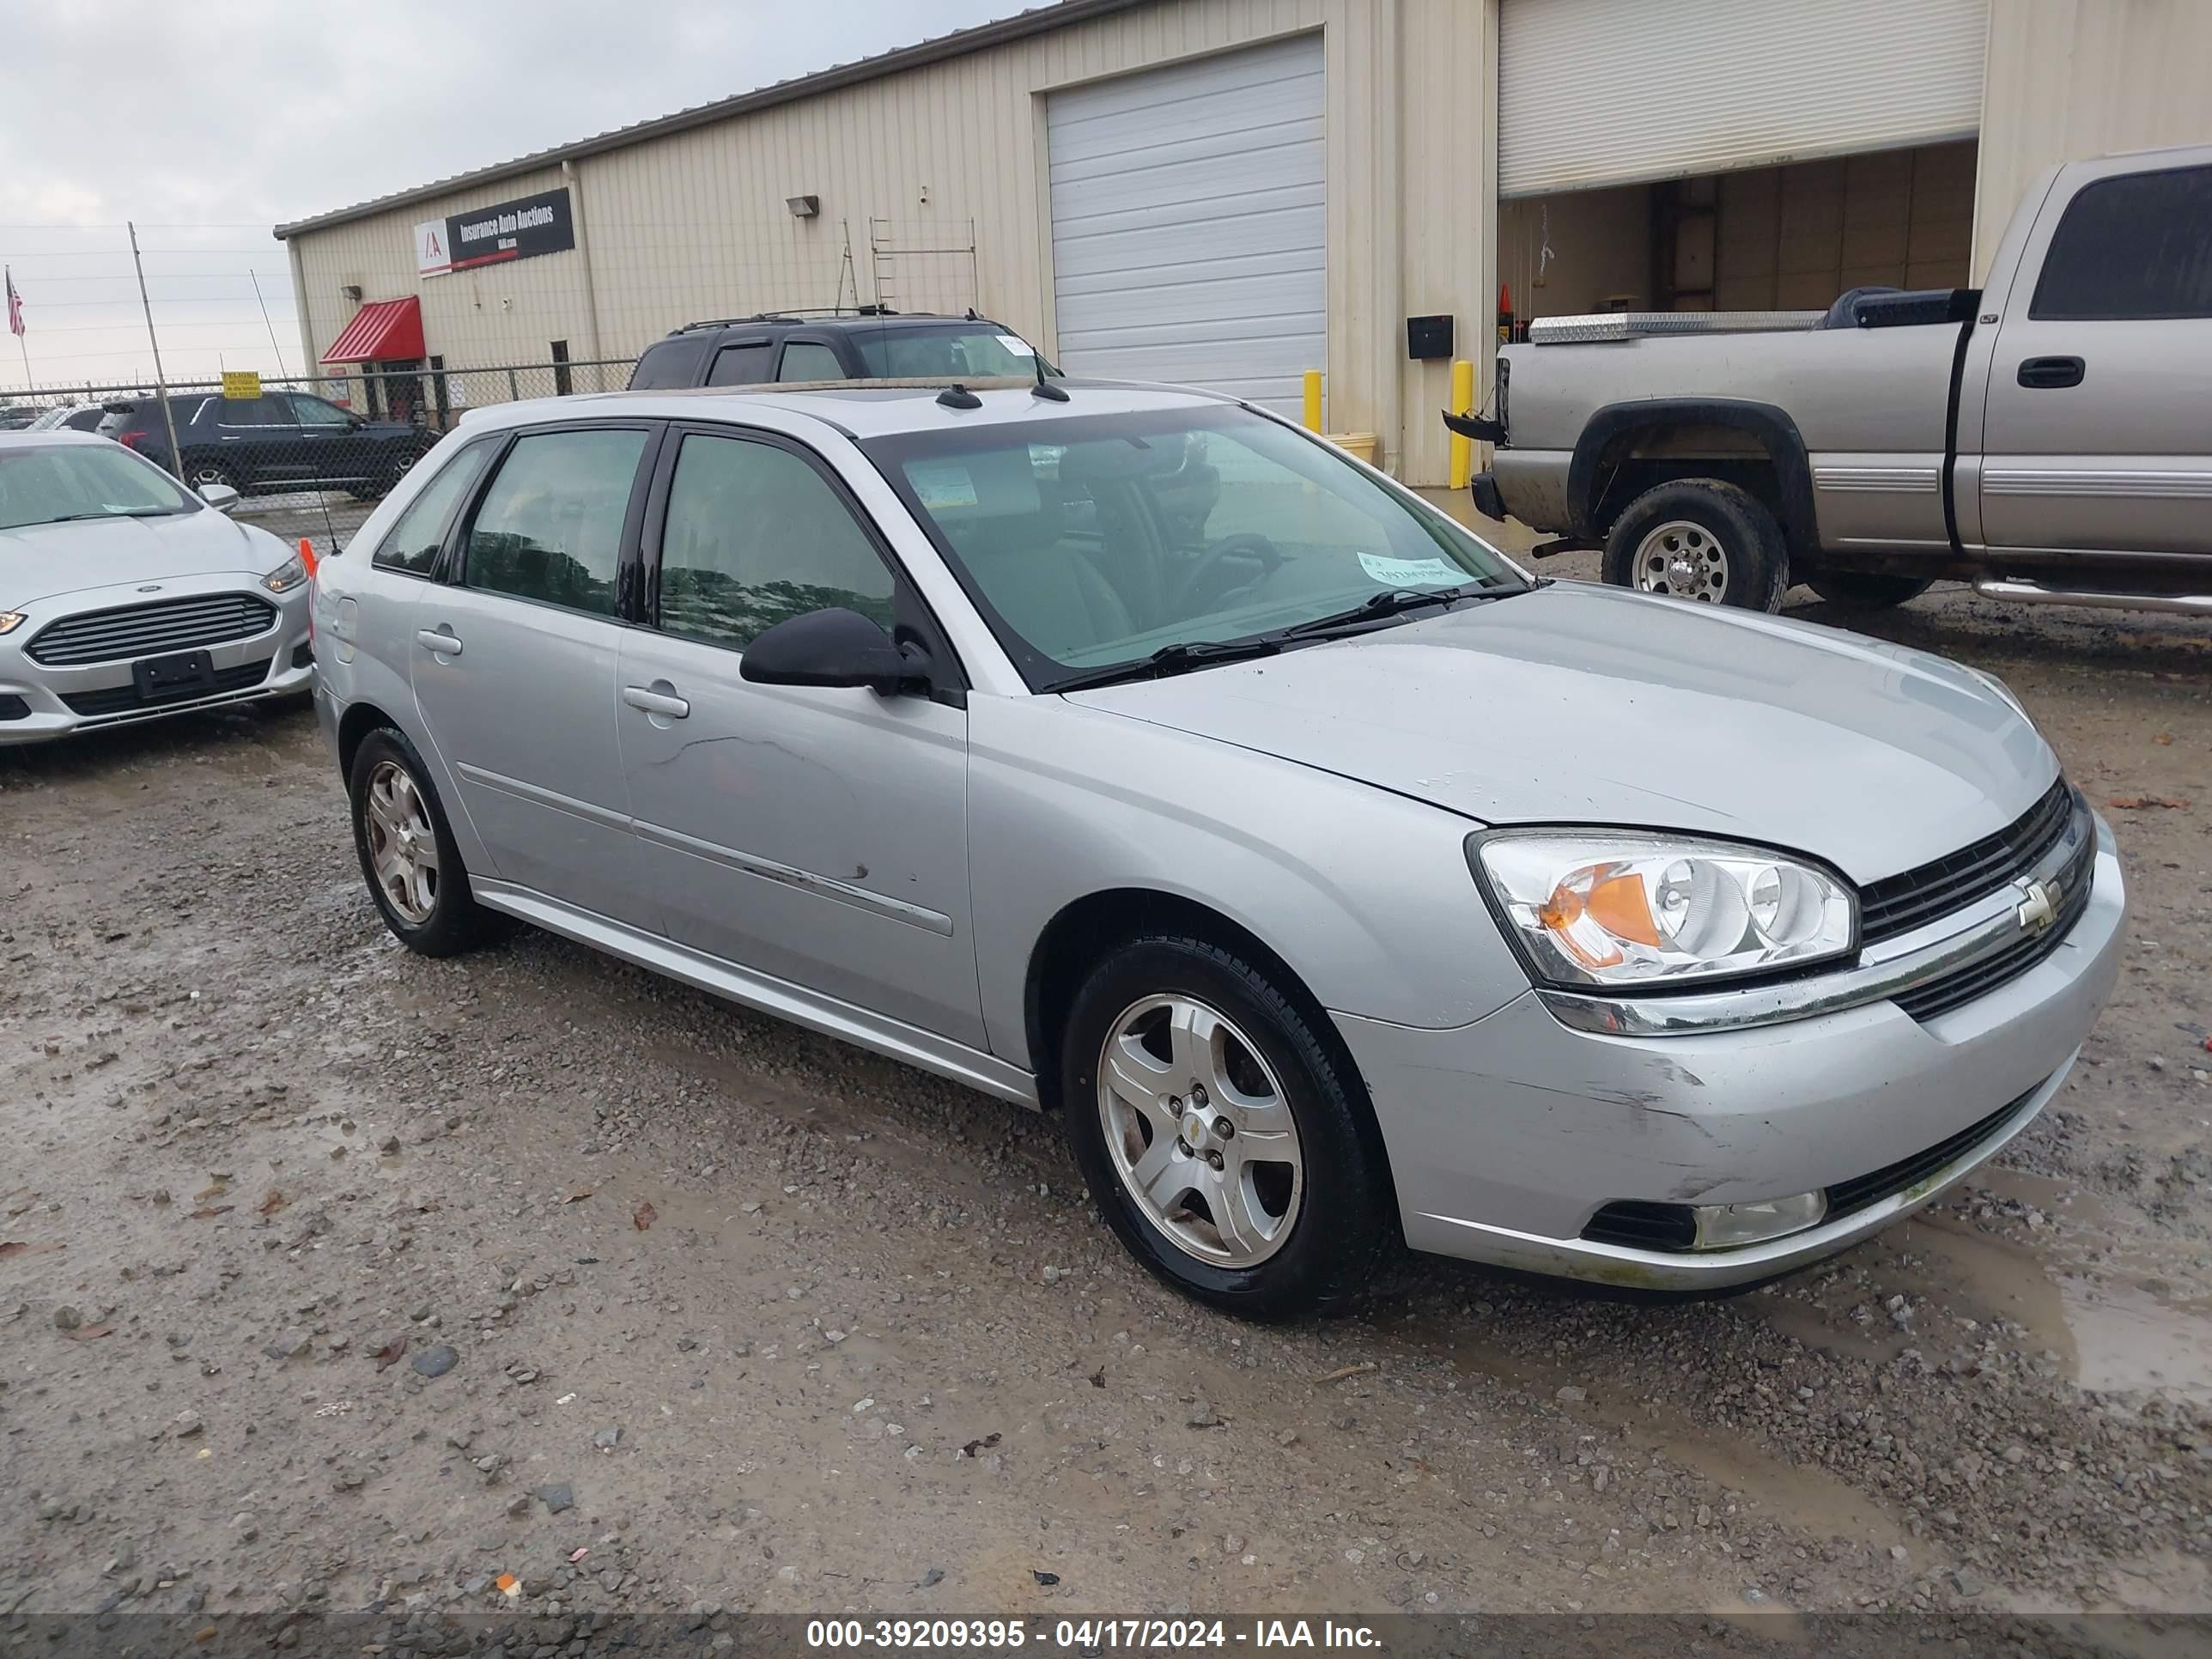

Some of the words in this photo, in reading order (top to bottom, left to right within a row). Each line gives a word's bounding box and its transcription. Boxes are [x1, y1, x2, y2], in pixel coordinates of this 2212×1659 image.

[461, 220, 498, 242] Insurance
[499, 214, 517, 234] Auto
[517, 206, 554, 229] Auctions
